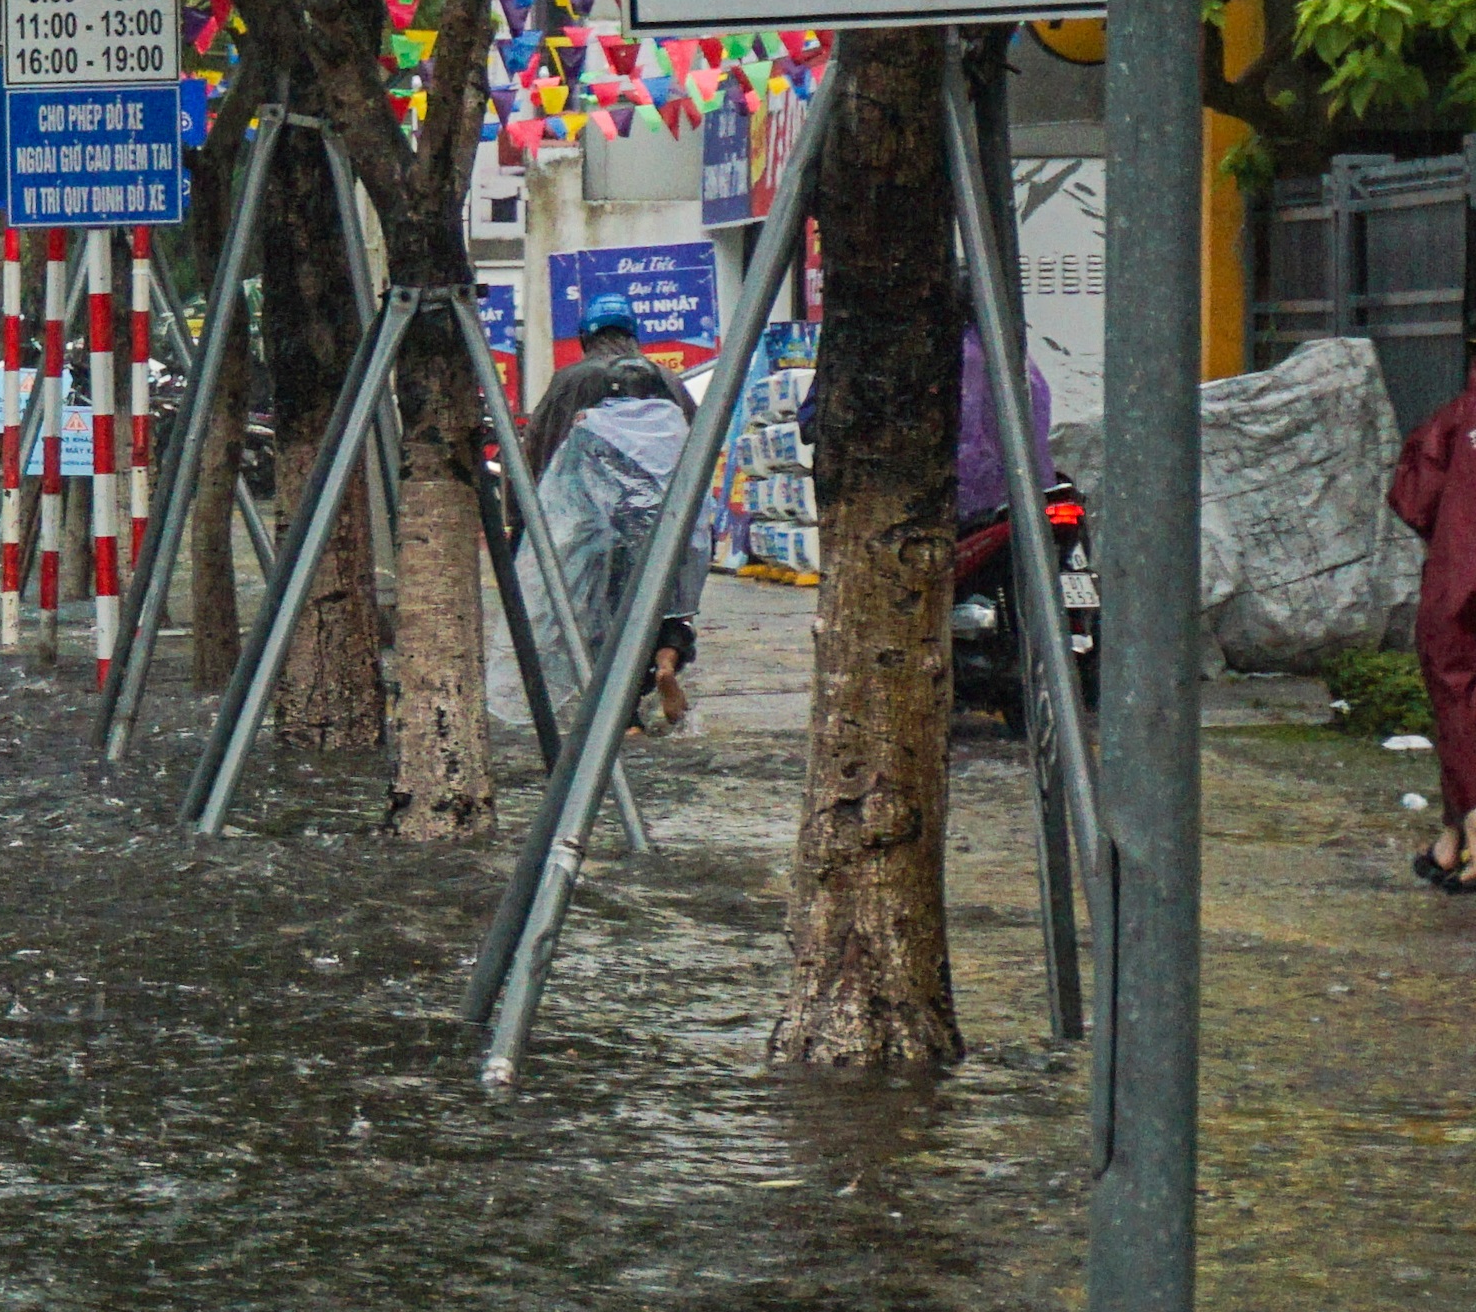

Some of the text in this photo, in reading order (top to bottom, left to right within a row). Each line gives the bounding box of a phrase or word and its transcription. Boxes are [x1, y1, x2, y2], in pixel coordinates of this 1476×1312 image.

[16, 12, 77, 40] 11:00
[101, 9, 163, 37] 13:00
[16, 47, 78, 75] 16:00
[102, 45, 164, 73] 19:00
[38, 104, 65, 132] CHO
[68, 98, 102, 131] PHÉP
[127, 102, 144, 130] XE
[16, 140, 57, 174] NGOÀI
[60, 139, 82, 173] GIỜ
[86, 144, 111, 172] CAO
[114, 131, 148, 171] ĐIỂM
[24, 187, 37, 219] VỊ
[40, 180, 60, 215] TRÍ
[64, 186, 89, 216] QUY
[92, 186, 123, 218] ĐỊNH
[148, 184, 167, 211] XE
[653, 296, 700, 314] NHẬT
[643, 312, 685, 333] TUỔI
